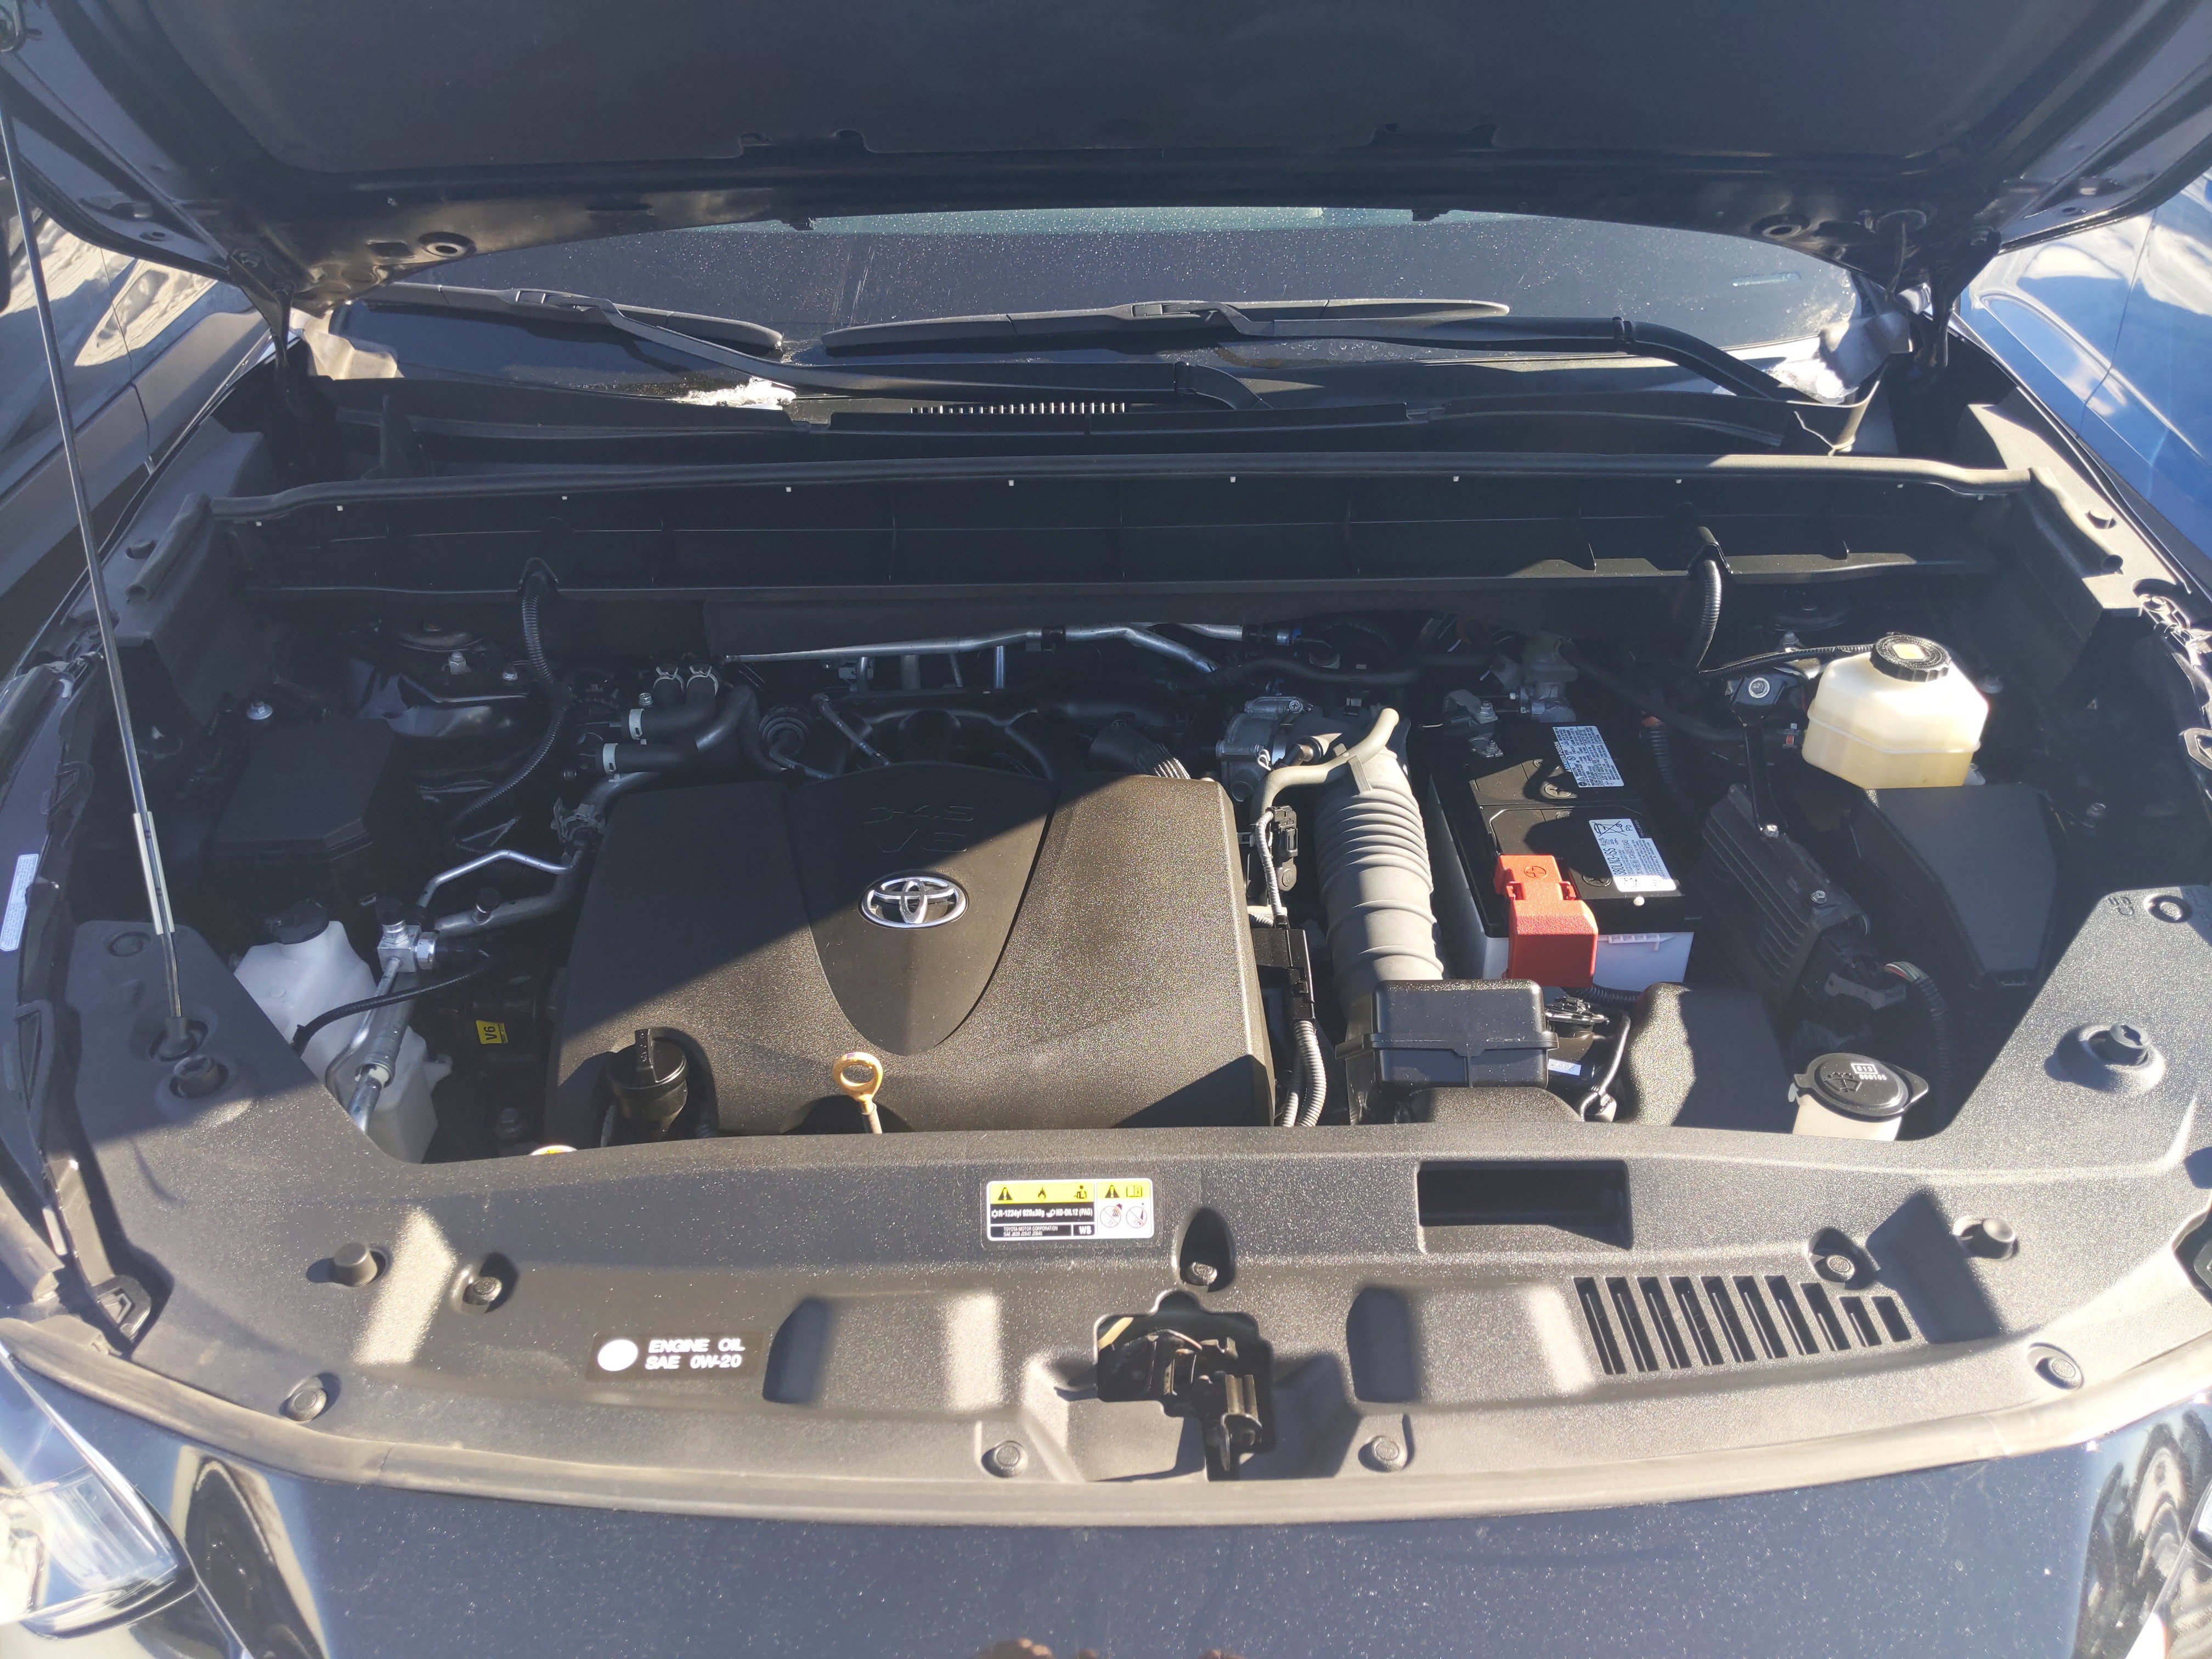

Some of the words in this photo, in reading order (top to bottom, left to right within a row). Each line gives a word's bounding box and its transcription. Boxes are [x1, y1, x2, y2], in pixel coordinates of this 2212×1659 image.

[1602, 848, 1627, 875] 380LN3-ISS
[483, 1026, 498, 1041] V6
[648, 1338, 710, 1353] ENGINE
[718, 1338, 746, 1352] OIL
[645, 1355, 681, 1370] SAE
[689, 1354, 742, 1369] 0W-20
